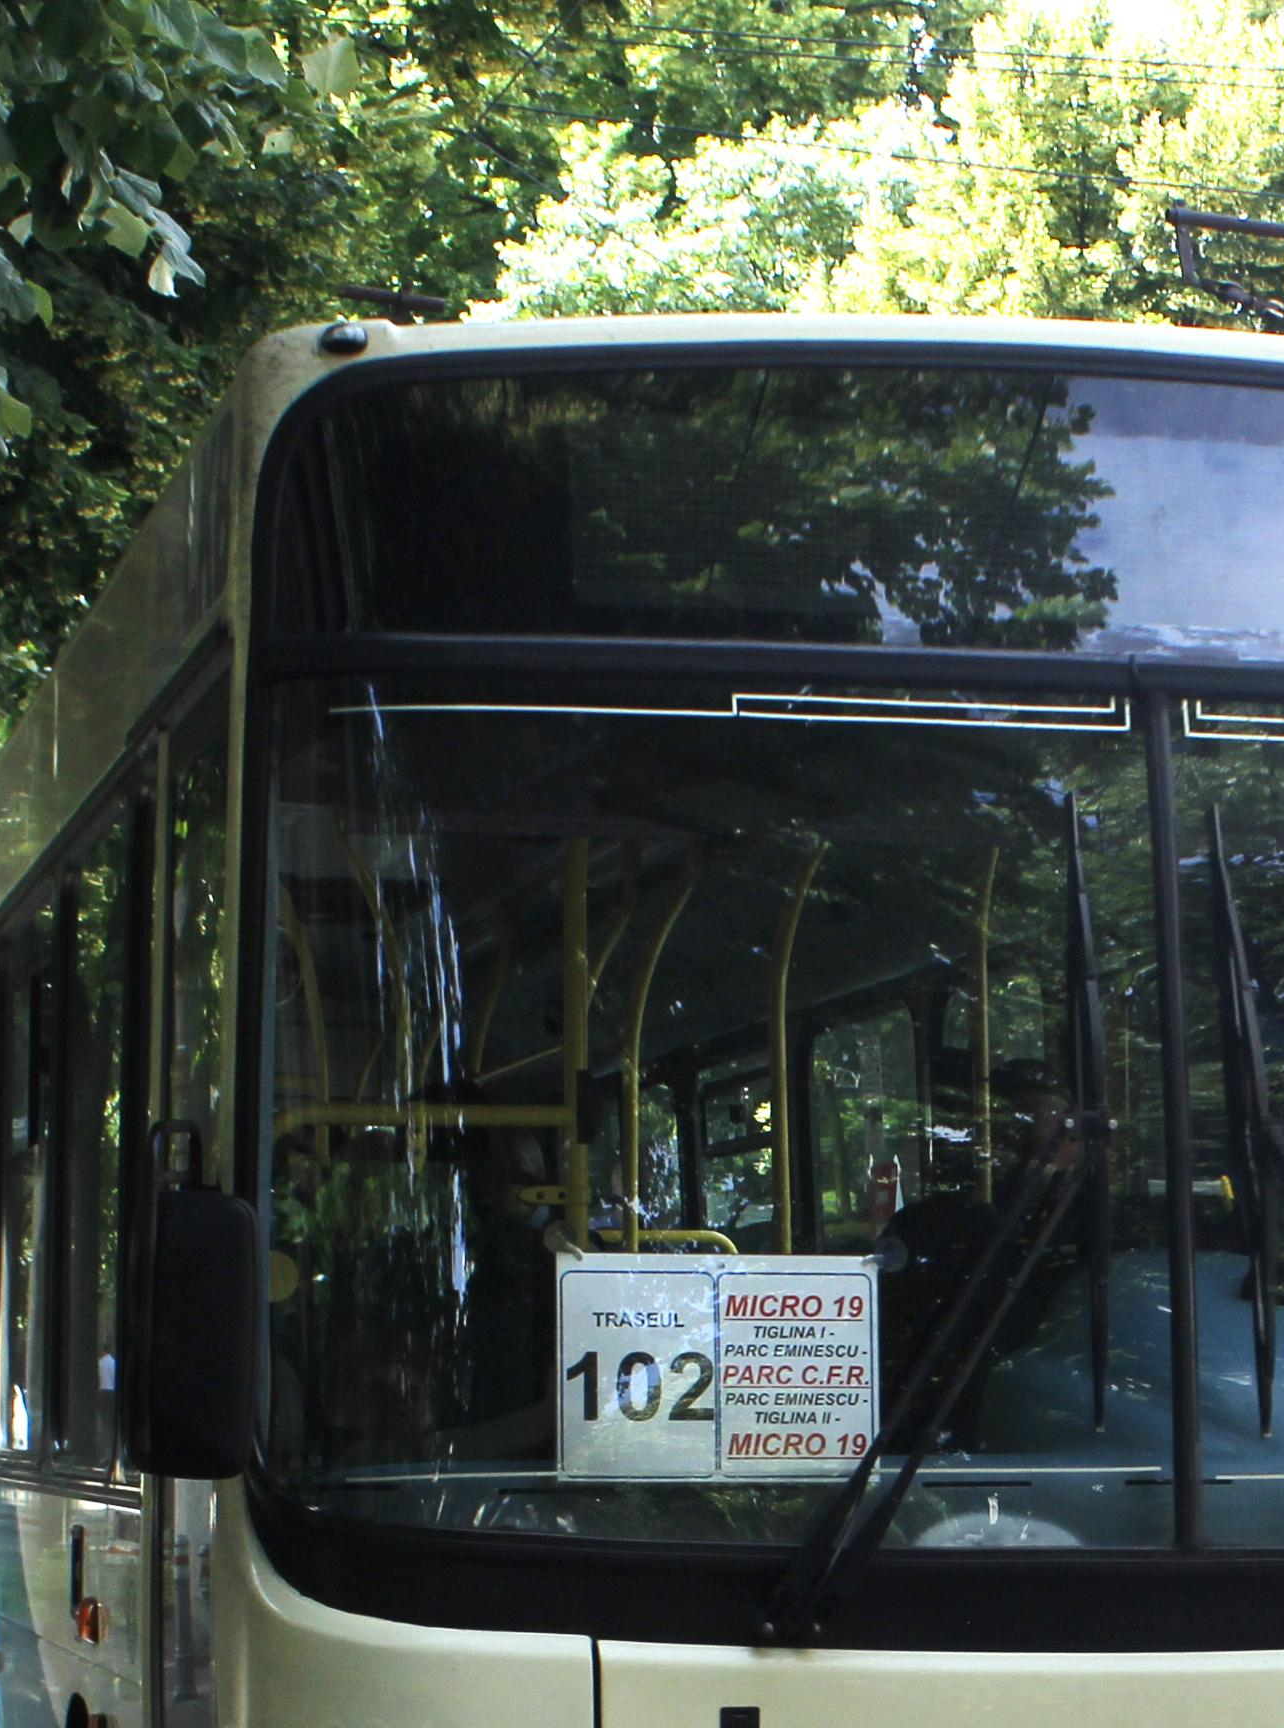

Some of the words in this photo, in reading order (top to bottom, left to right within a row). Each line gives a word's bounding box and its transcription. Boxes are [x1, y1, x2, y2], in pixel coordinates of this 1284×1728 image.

[724, 1295, 822, 1318] MICRO
[833, 1295, 864, 1318] 19
[592, 1312, 685, 1329] TRASEUL
[753, 1326, 816, 1339] TIGLINA
[819, 1326, 826, 1339] I
[724, 1344, 769, 1357] PARC
[773, 1344, 860, 1358] EMINESCU
[723, 1365, 794, 1385] PARC
[801, 1365, 869, 1386] C.F.R.
[566, 1351, 715, 1421] 102
[724, 1393, 769, 1406] PARC
[773, 1393, 860, 1407] EMINESCU
[754, 1411, 818, 1425] TIGLINA
[821, 1411, 832, 1424] II
[728, 1433, 826, 1456] MICRO
[836, 1433, 868, 1456] 19
